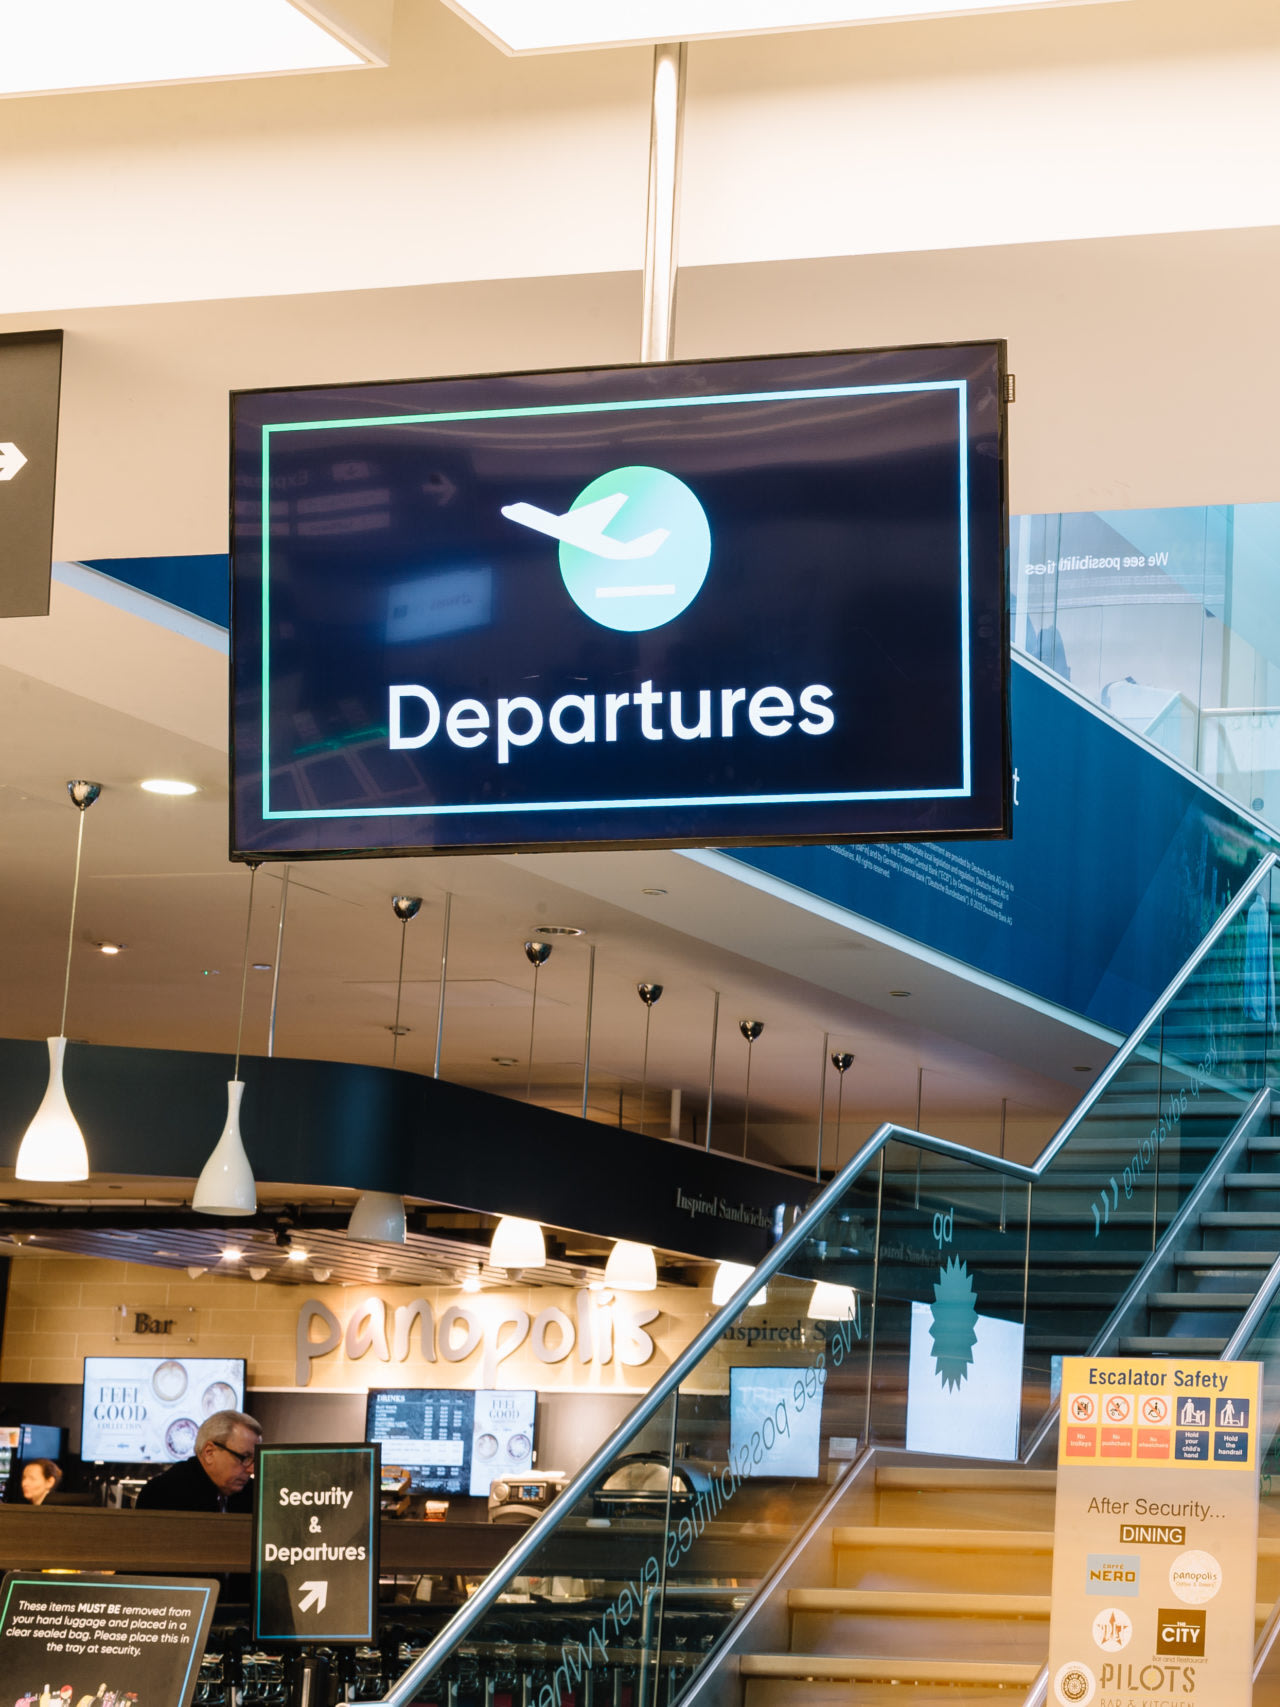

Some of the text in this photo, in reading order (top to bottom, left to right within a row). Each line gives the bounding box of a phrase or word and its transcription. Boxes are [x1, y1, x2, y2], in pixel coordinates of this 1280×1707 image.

[388, 681, 835, 763] Departures
[676, 1187, 773, 1230] Inspired Sandwiches
[133, 1312, 174, 1334] Bar
[294, 1287, 661, 1391] panopolis
[721, 1318, 801, 1347] nspired
[1089, 1368, 1228, 1392] Escalator Safety
[100, 1386, 141, 1403] FEEL
[94, 1404, 147, 1421] GOOD
[1070, 1440, 1092, 1448] trolleys
[1218, 1448, 1243, 1456] handrail
[279, 1487, 353, 1509] Security
[1087, 1496, 1226, 1522] After Security...
[309, 1516, 322, 1533] &
[1123, 1527, 1183, 1543] DINING
[264, 1543, 366, 1565] Departures
[1090, 1570, 1136, 1583] NERO
[1173, 1571, 1218, 1583] panopolis
[19, 1600, 191, 1617] These items MUST BE removed from
[12, 1614, 187, 1630] your hand luggage and placed in a
[6, 1627, 190, 1644] clear sealed bag. Please place this in
[1161, 1627, 1201, 1643] CITY
[46, 1641, 141, 1657] the tray at security.
[1099, 1663, 1196, 1693] PILOTS
